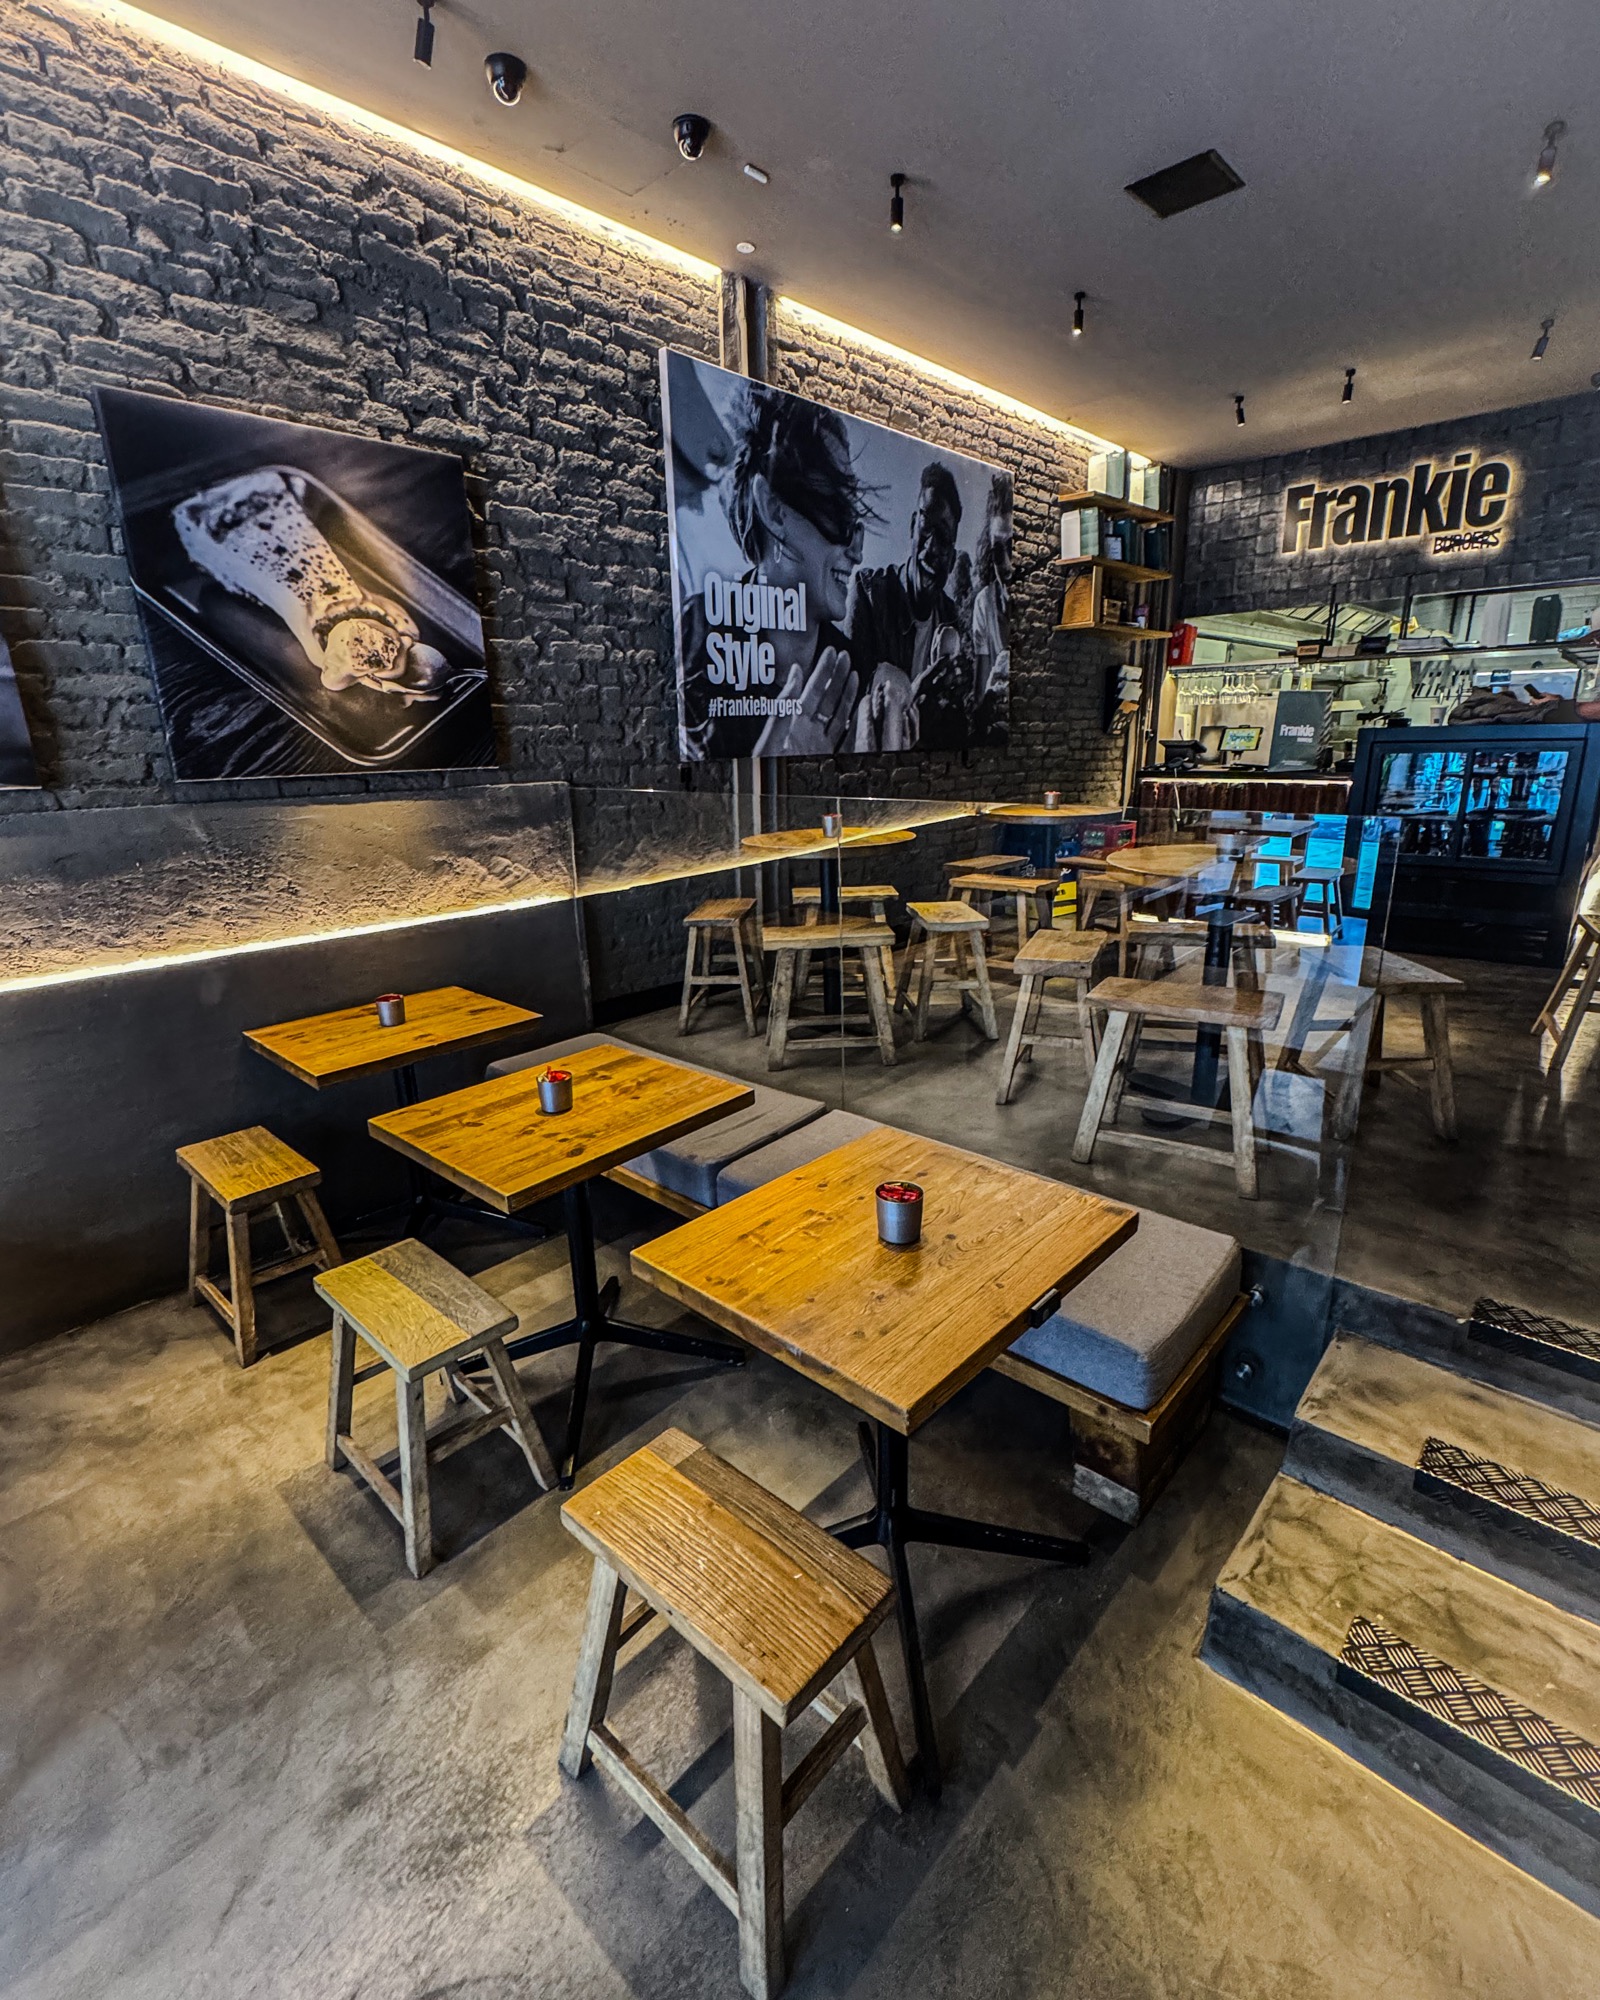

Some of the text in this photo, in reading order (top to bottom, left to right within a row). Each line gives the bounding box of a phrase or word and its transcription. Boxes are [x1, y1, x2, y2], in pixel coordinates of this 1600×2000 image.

[1282, 453, 1510, 554] Frankie
[704, 571, 807, 634] Original
[706, 632, 776, 691] Style
[708, 696, 803, 718] #FrankieBurgers
[1280, 724, 1315, 737] Frankie
